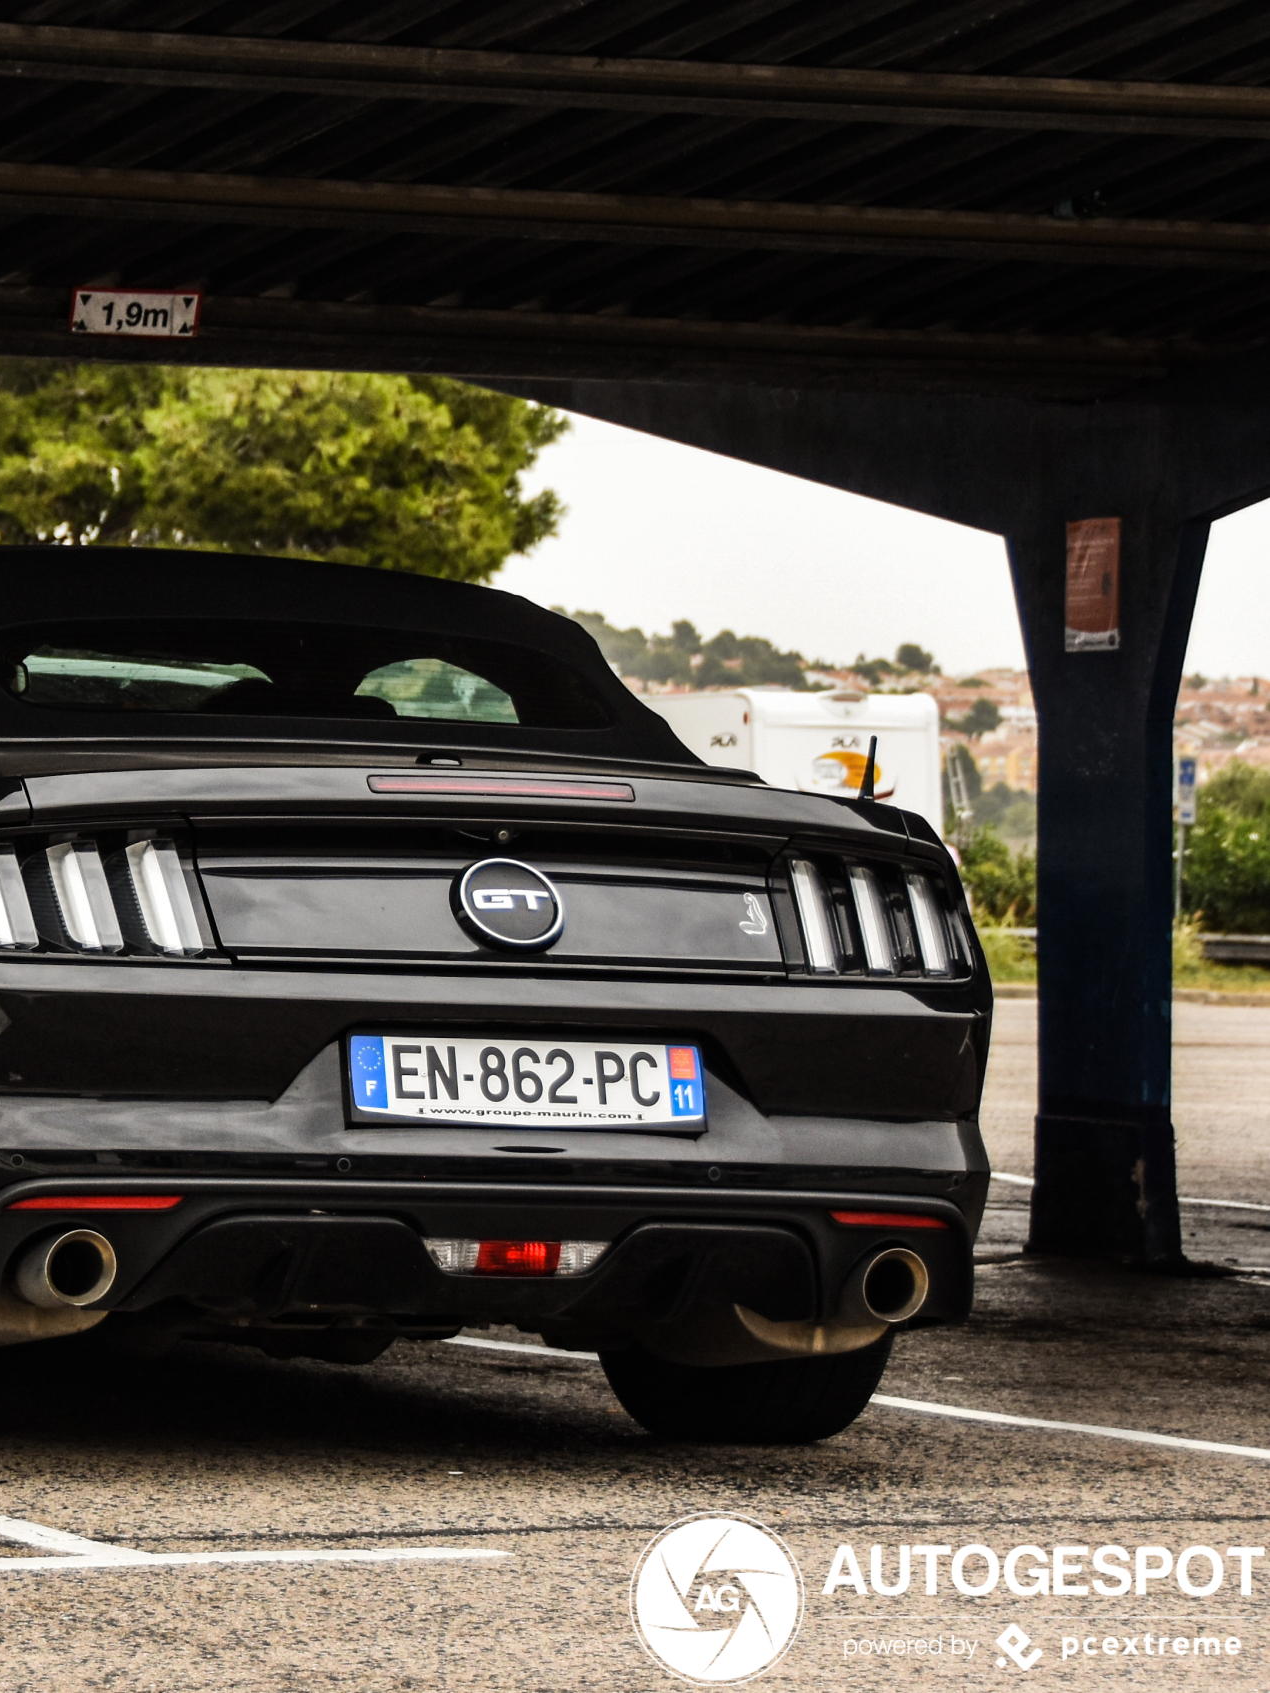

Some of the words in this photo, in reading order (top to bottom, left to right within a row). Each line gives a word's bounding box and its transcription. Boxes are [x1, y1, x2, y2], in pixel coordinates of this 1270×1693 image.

[102, 301, 169, 330] 1,9m
[472, 888, 549, 910] GT
[391, 1044, 661, 1107] EN-862-PC
[365, 1080, 377, 1096] F
[674, 1084, 694, 1109] 11
[429, 1107, 632, 1120] www.groupe-maurin.com
